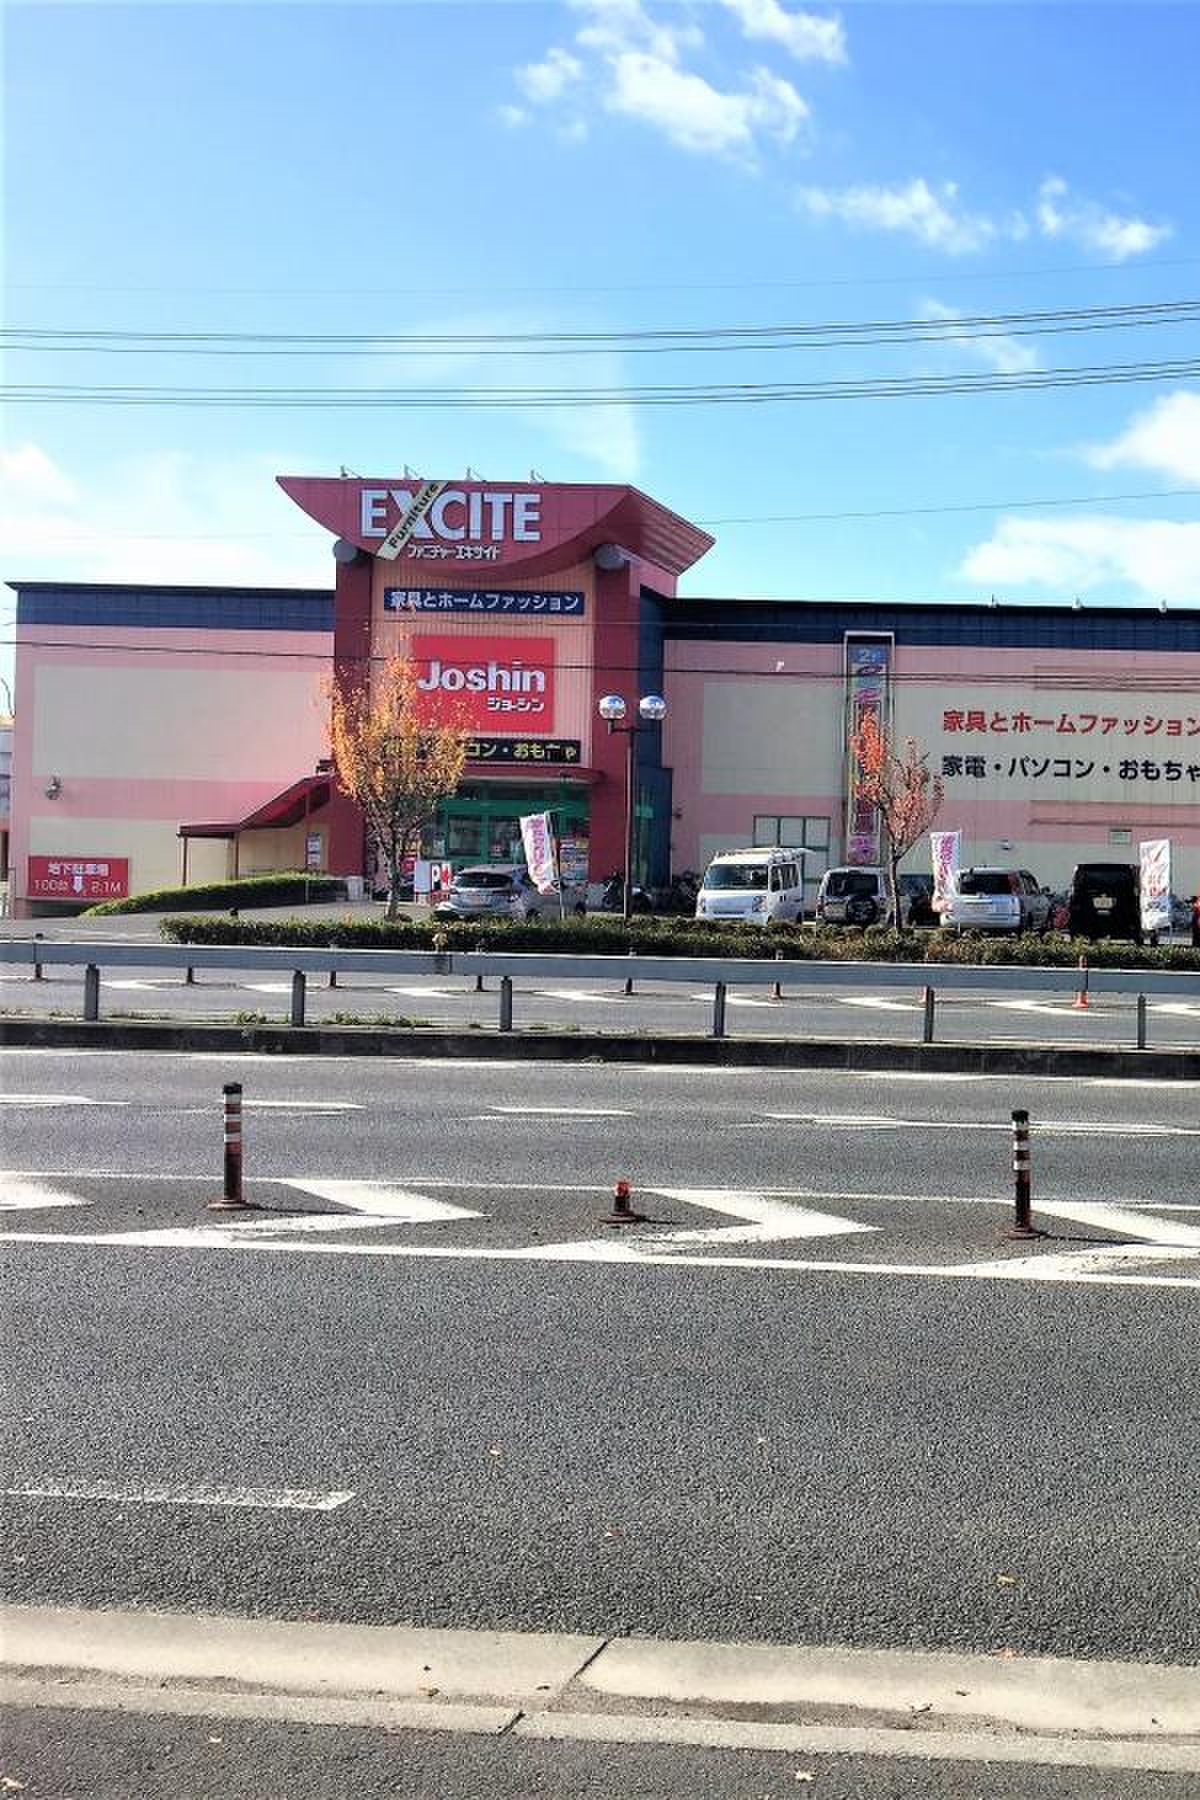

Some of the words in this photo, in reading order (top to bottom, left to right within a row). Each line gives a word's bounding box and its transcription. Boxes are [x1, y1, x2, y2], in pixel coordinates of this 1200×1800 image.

[360, 488, 541, 542] EXCITE
[387, 482, 440, 549] Furniture
[391, 591, 579, 611] 家具とホームファッション
[417, 661, 545, 692] Joshin
